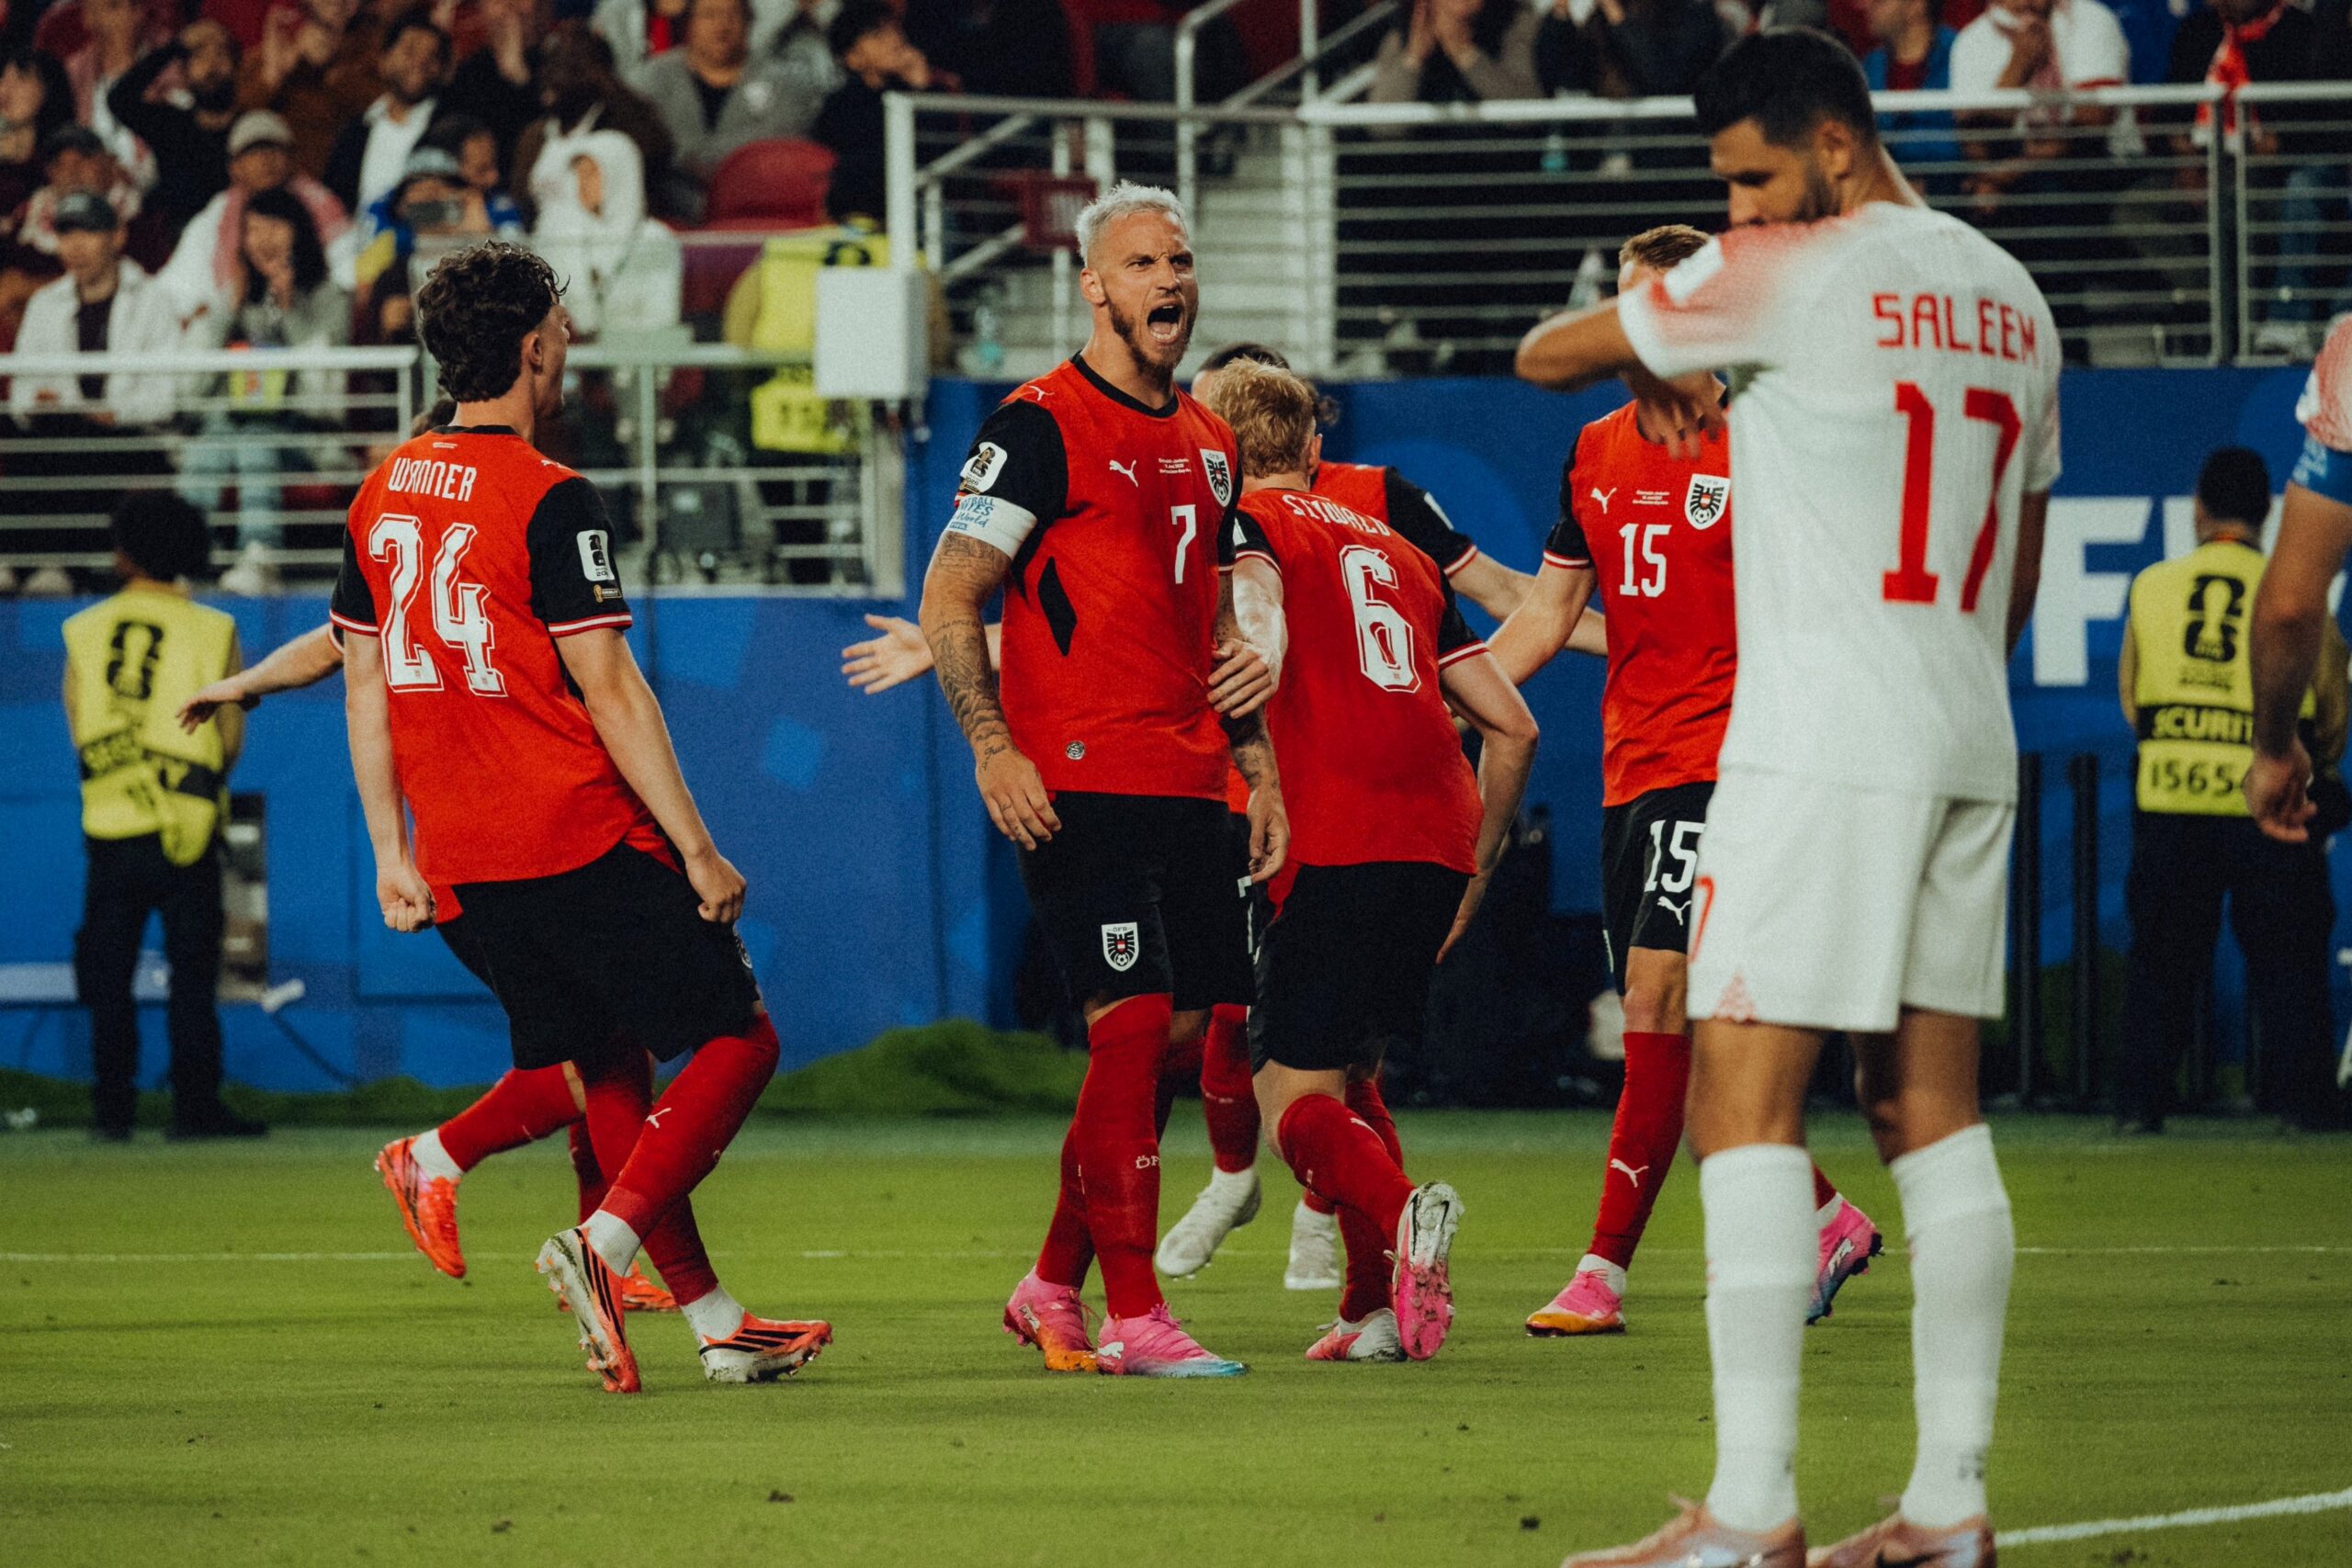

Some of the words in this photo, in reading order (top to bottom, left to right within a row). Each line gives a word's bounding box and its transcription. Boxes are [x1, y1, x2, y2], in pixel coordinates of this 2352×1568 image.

[1871, 291, 2039, 367] SALEEM
[387, 457, 478, 502] WANNER
[1883, 380, 2023, 613] 17
[1170, 503, 1197, 585] 7
[1619, 523, 1673, 598] 15
[368, 513, 509, 698] 24
[1339, 544, 1422, 694] 6
[2150, 757, 2243, 797] 1565
[1644, 819, 1707, 893] 15
[1135, 1155, 1160, 1169] ÖF
